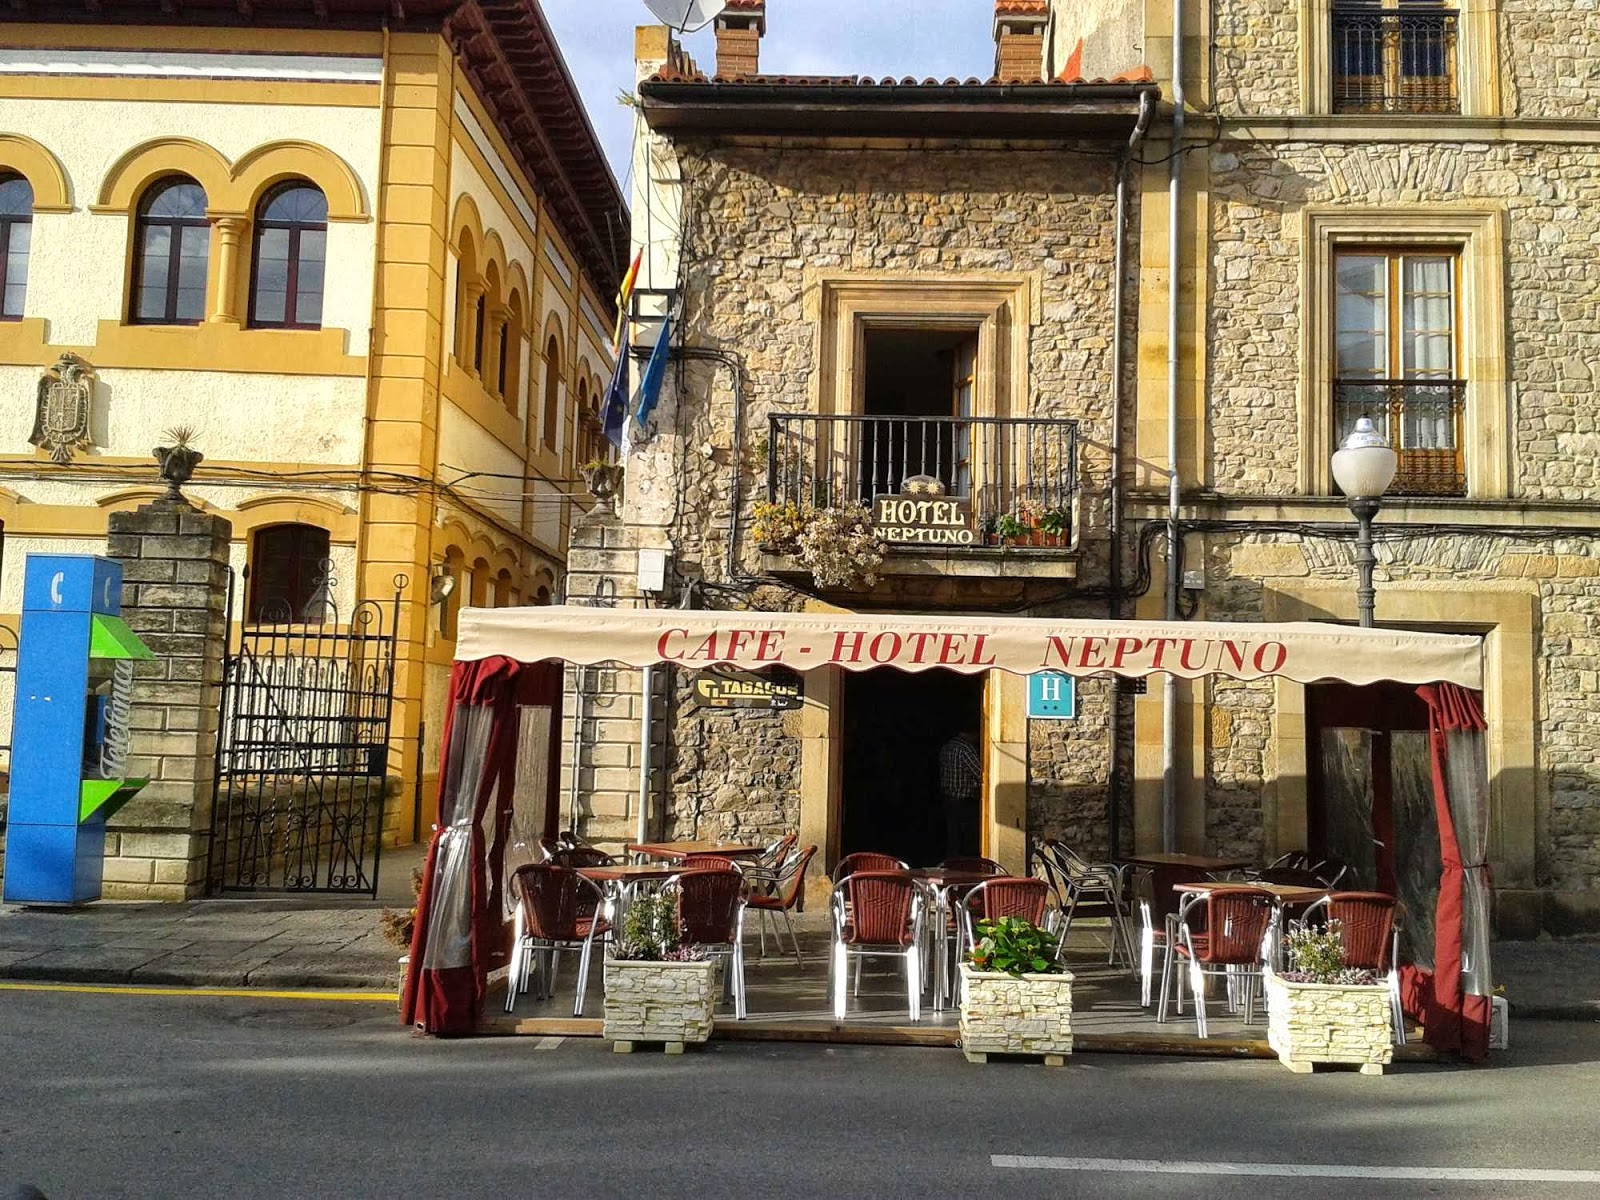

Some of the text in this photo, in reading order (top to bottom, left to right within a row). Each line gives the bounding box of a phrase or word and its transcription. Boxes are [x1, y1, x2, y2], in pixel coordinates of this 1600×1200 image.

[880, 500, 965, 525] HOTEL
[872, 527, 973, 544] NEPTUNO
[657, 628, 786, 661] CAFE
[828, 631, 998, 666] HOTEL
[1040, 635, 1288, 673] NEPTUNO
[1041, 677, 1061, 701] H
